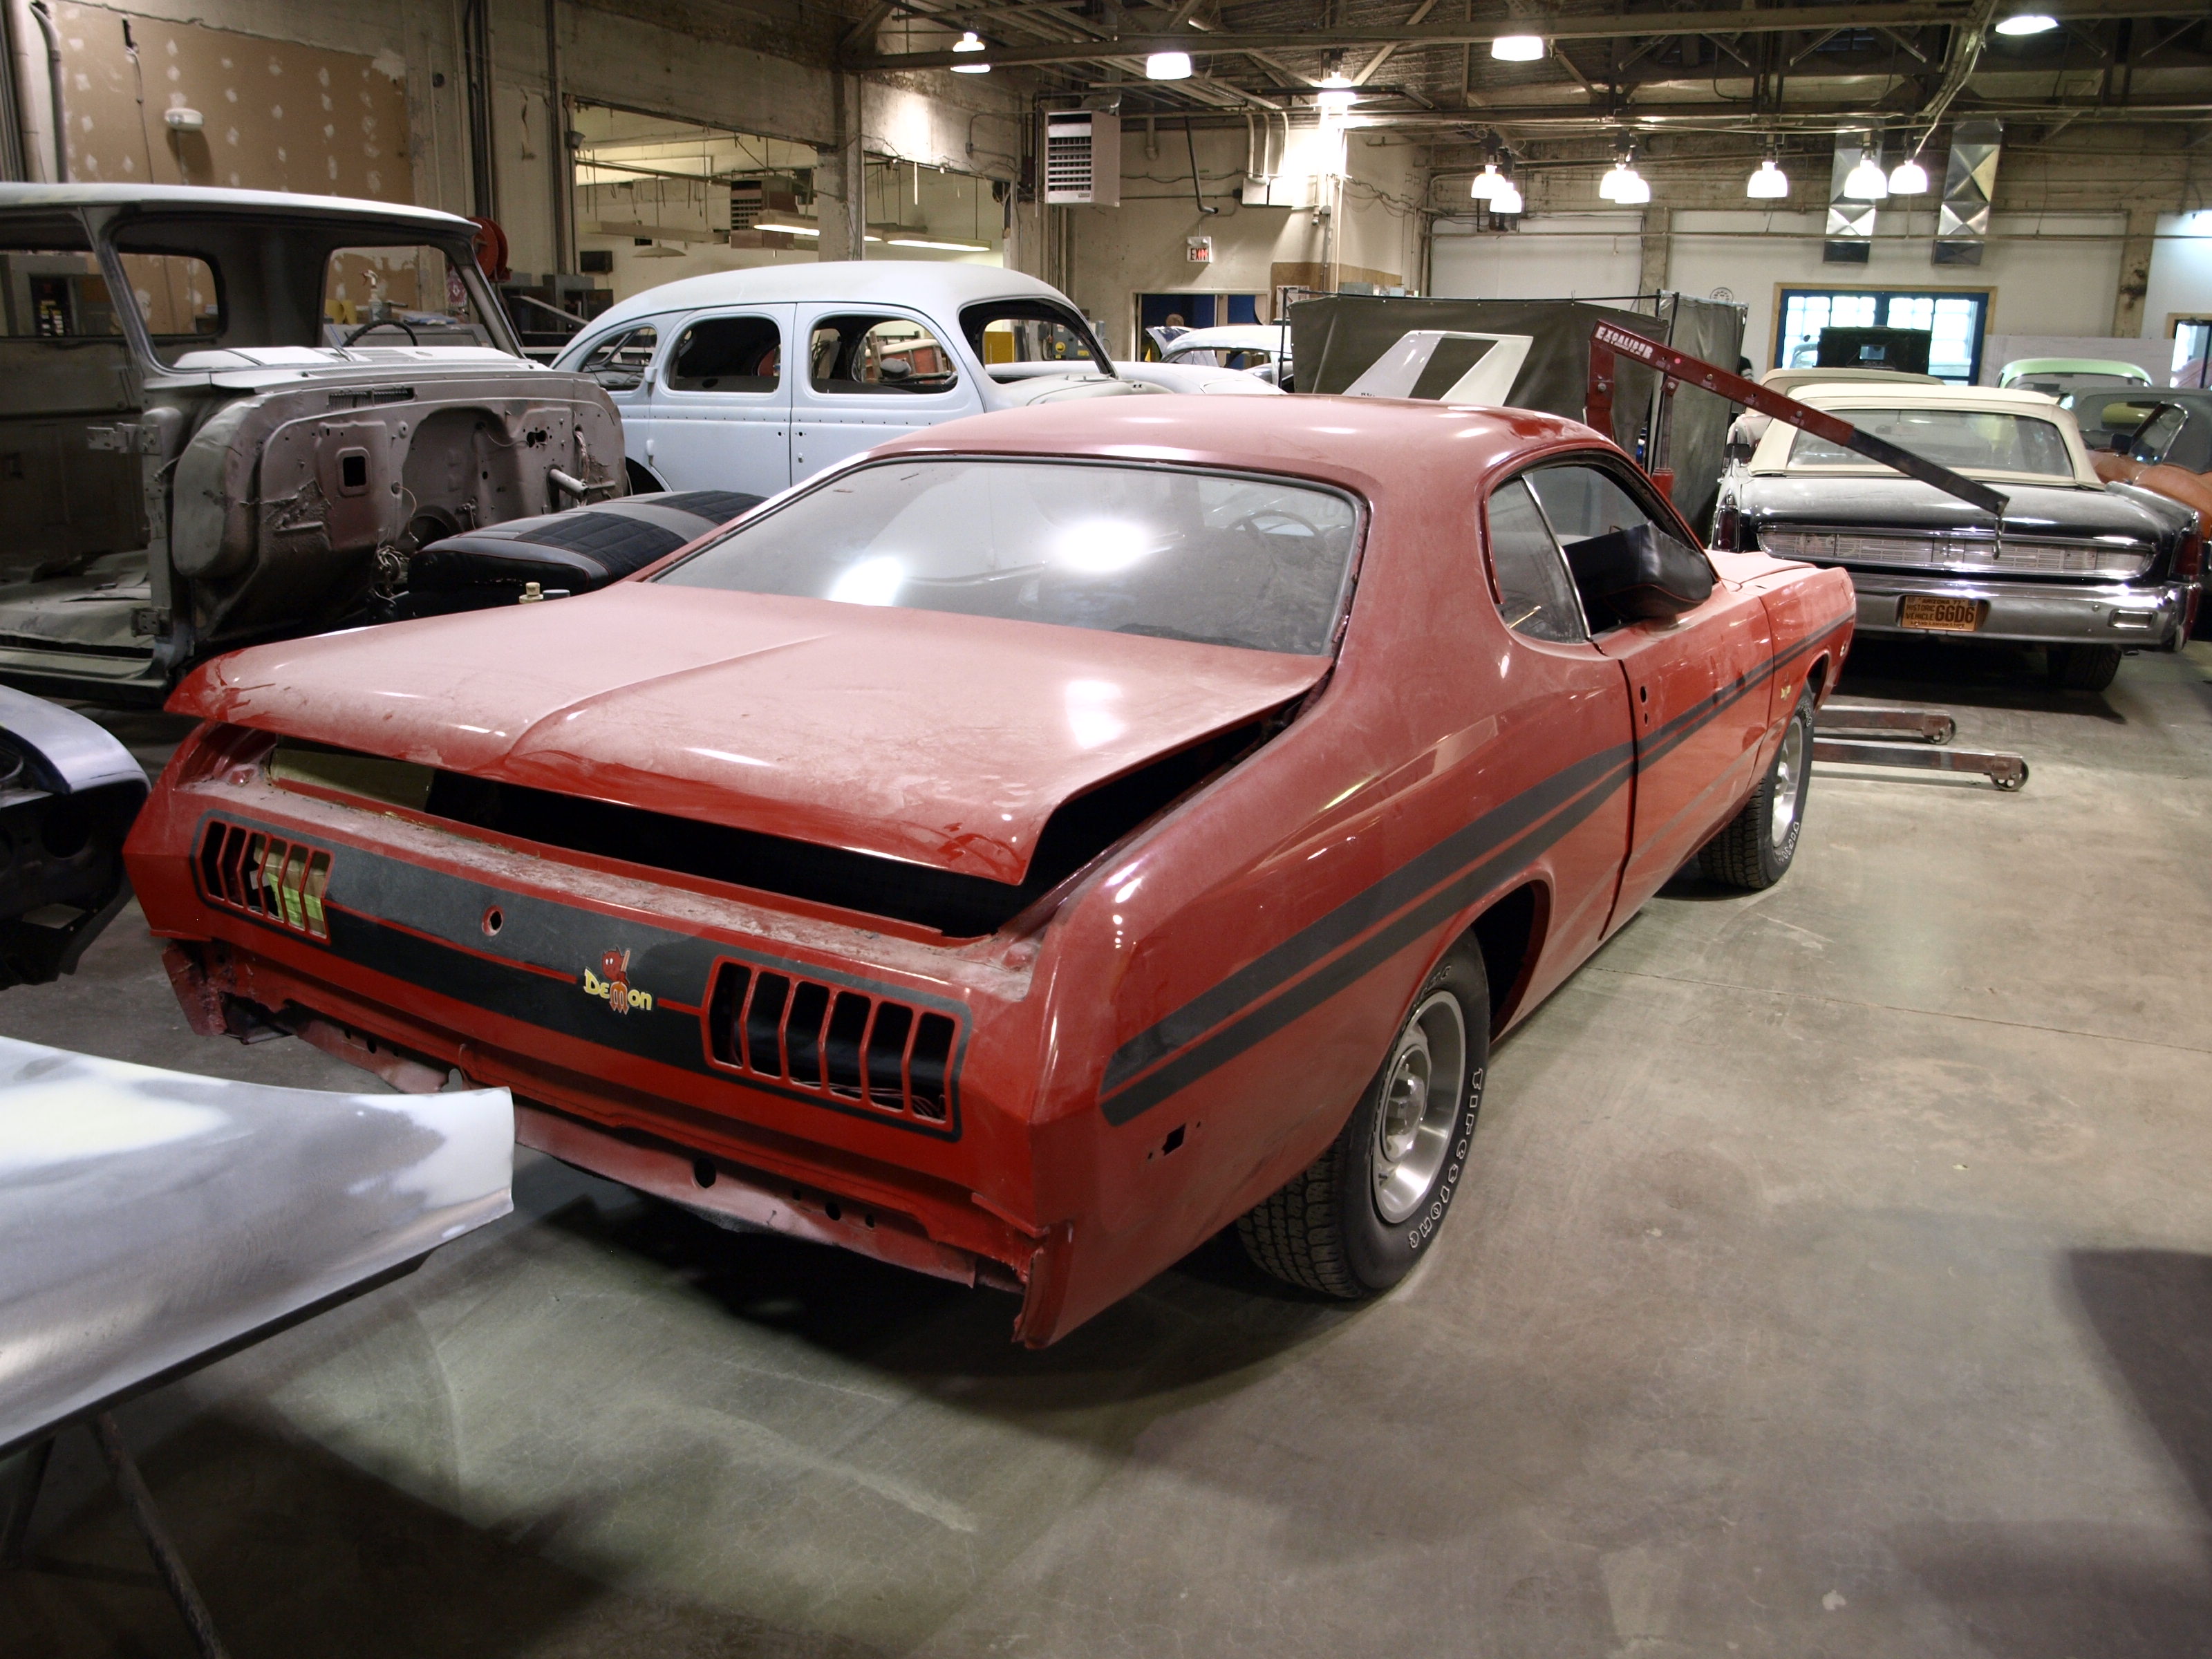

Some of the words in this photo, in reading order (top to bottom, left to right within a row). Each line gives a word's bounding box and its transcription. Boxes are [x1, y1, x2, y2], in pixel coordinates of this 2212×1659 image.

[1190, 247, 1207, 260] EXIT
[1595, 326, 1654, 360] EXCALIBUR
[1906, 612, 1934, 621] VEHICLE
